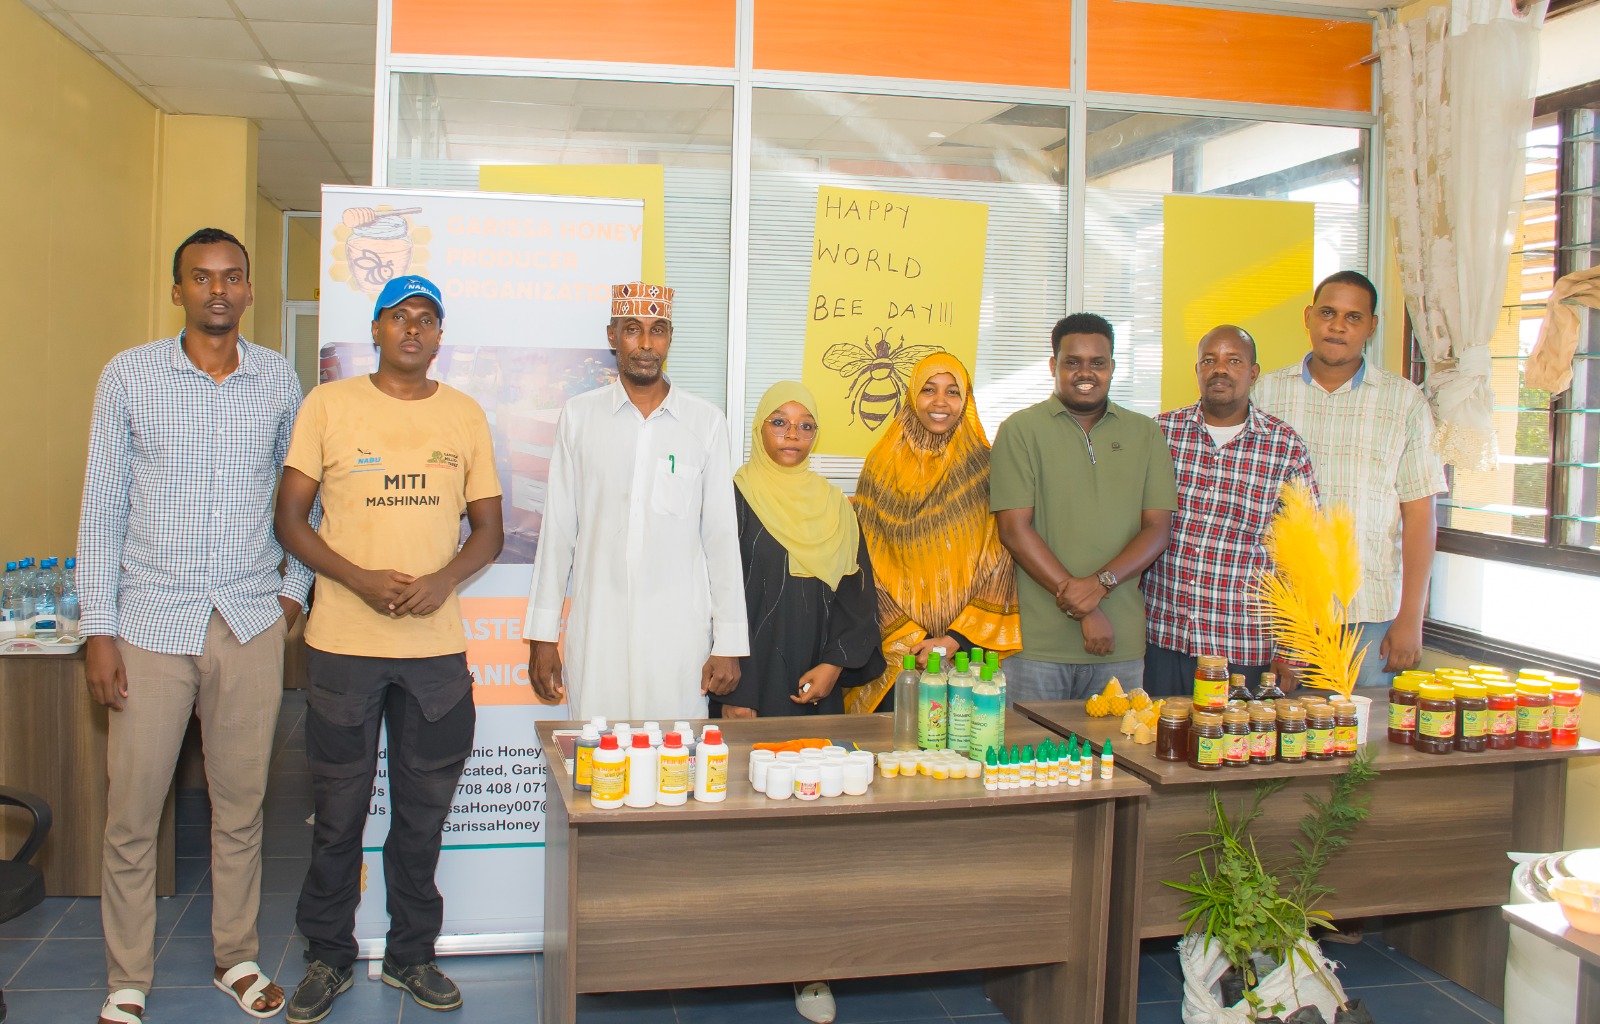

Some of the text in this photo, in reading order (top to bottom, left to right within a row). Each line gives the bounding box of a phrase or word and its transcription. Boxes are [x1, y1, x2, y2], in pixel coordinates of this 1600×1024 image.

[826, 195, 910, 229] HAPPY
[447, 216, 643, 242] GARISSA HONEY
[447, 247, 577, 270] PRODUCER
[817, 239, 922, 279] WORLD
[445, 277, 611, 303] ORGANIZATIO
[813, 294, 863, 321] BEE
[357, 456, 382, 465] NABU
[384, 473, 426, 490] MITI
[366, 495, 440, 507] MASHINANI
[462, 618, 521, 640] ASTE
[470, 663, 530, 686] ANIC
[472, 745, 542, 759] nic Honey
[463, 763, 546, 778] cated, Garis
[457, 783, 482, 795] 708
[486, 782, 512, 794] 408
[523, 781, 546, 793] 071
